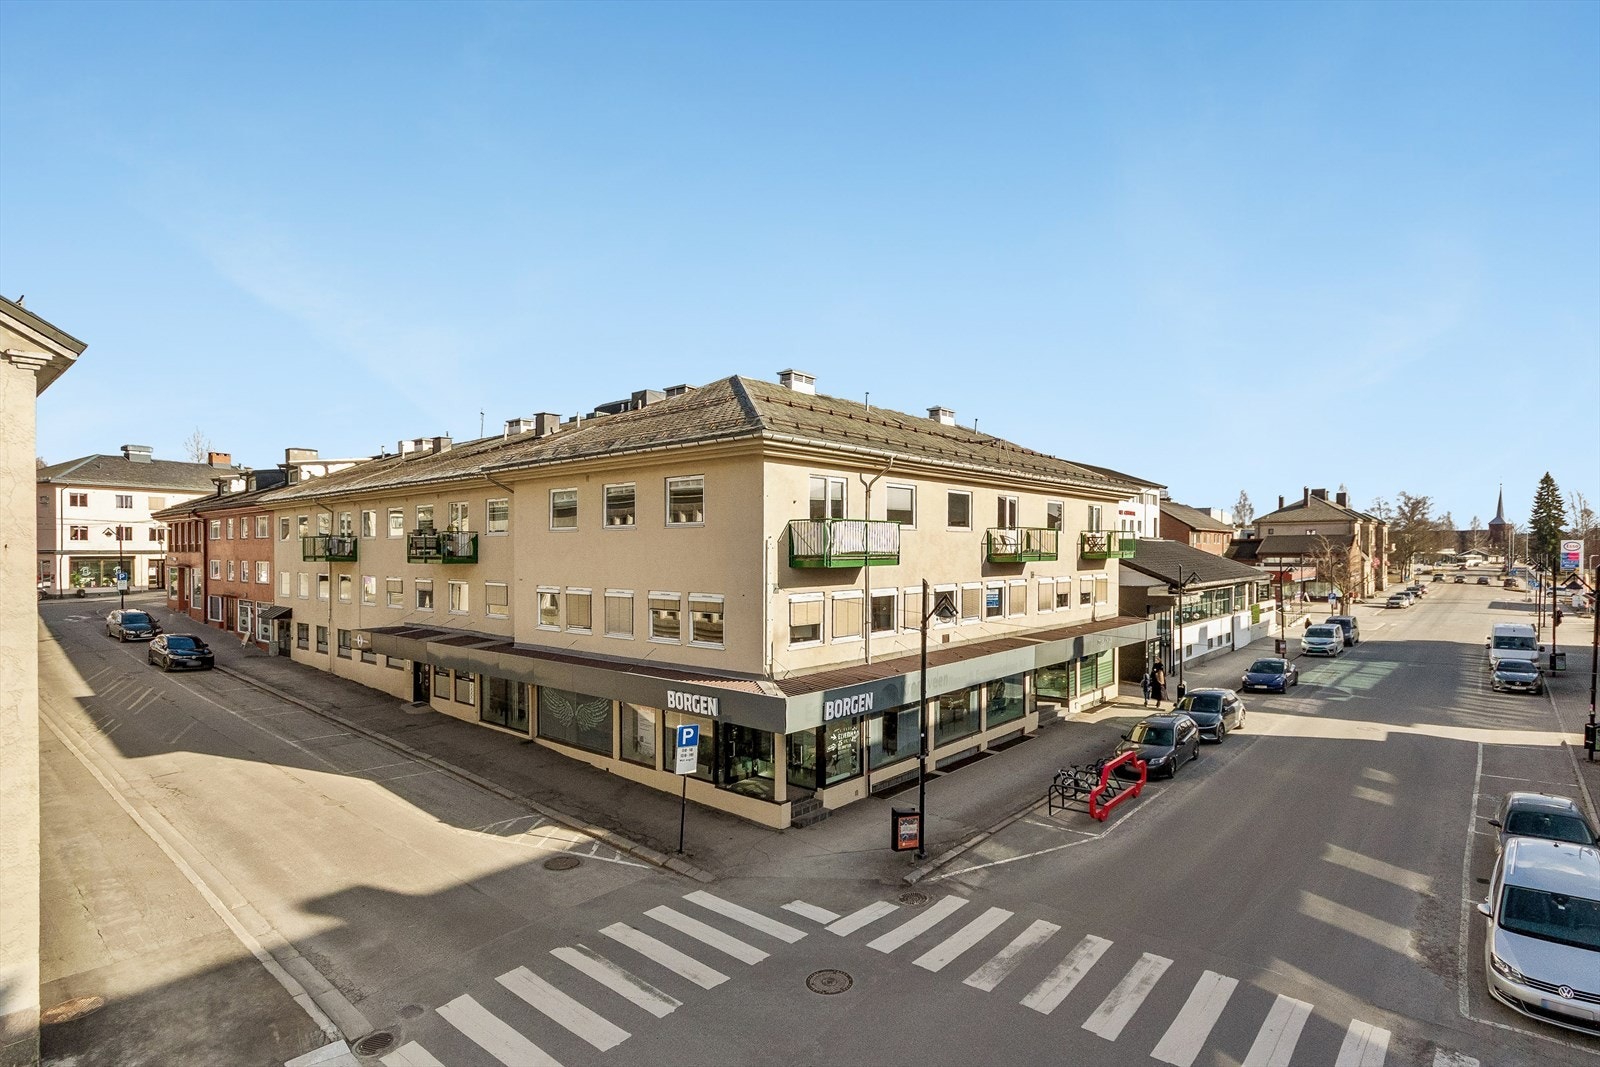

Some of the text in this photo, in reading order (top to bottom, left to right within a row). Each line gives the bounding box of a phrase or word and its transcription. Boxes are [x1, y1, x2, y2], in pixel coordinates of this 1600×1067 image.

[667, 690, 719, 717] BORGEN
[824, 692, 874, 721] BORGEN
[682, 728, 694, 745] P
